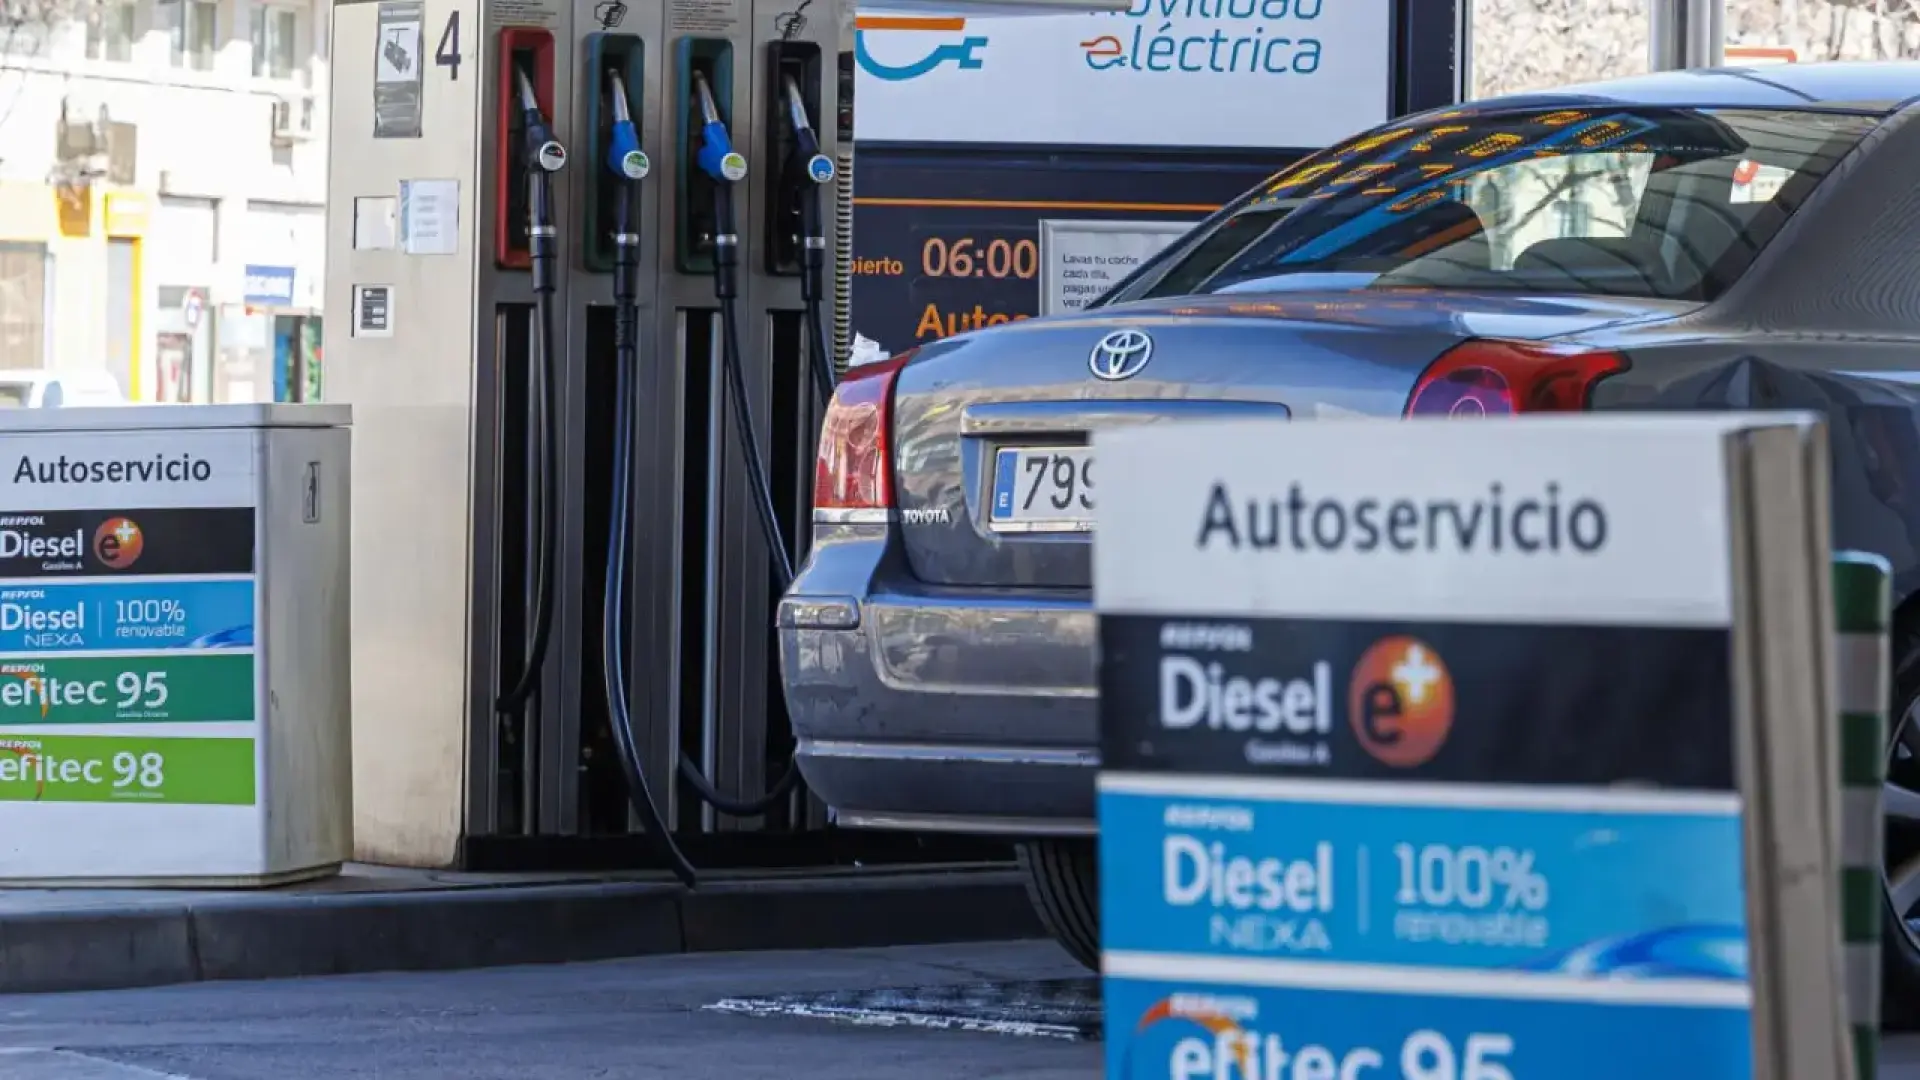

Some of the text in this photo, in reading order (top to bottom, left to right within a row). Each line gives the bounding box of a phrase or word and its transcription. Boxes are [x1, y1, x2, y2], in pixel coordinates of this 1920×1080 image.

[435, 9, 462, 82] 4
[1080, 21, 1323, 75] eléctrica
[922, 236, 1038, 279] 06:00
[1063, 253, 1139, 266] Lavas tu coche
[13, 454, 212, 484] Autoservicio
[902, 509, 949, 525] TOYOTA
[998, 491, 1009, 508] E
[1196, 481, 1609, 554] Autoservicio
[0, 528, 84, 558] Diesel
[1, 599, 186, 631] Diesel 100%
[24, 624, 186, 647] NEXA renovable
[2, 671, 169, 709] efitec 95
[1160, 655, 1332, 734] Diesel
[0, 751, 164, 788] efitec 98
[1163, 833, 1550, 912] Diesel 100%
[1210, 911, 1550, 951] NEXA renovable
[1169, 1027, 1384, 1080] efitec
